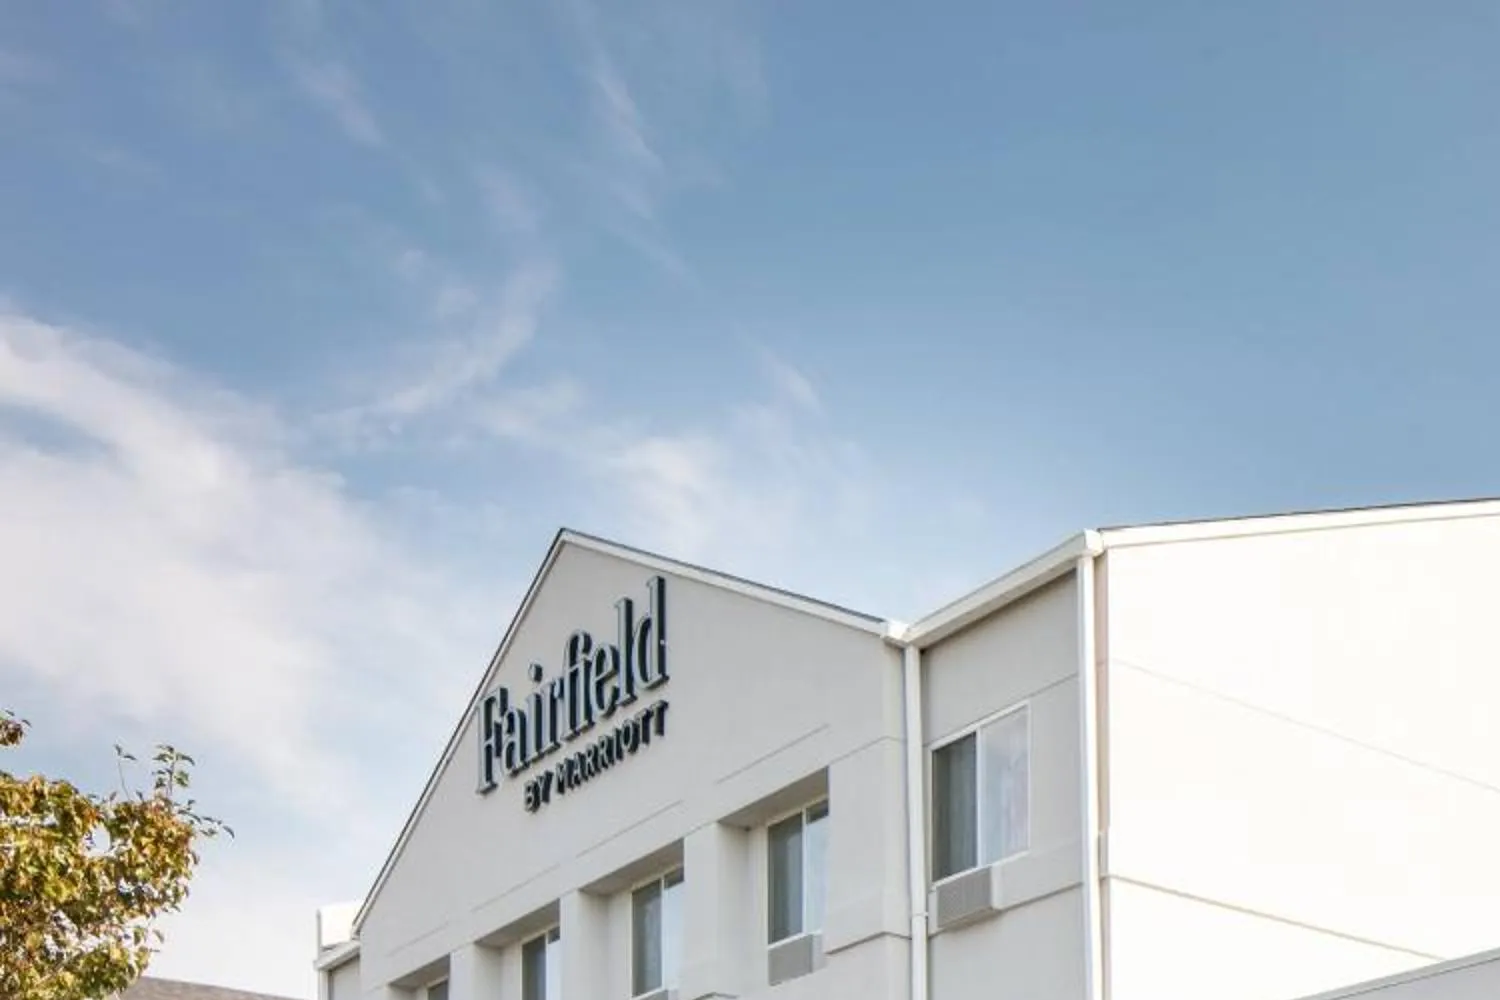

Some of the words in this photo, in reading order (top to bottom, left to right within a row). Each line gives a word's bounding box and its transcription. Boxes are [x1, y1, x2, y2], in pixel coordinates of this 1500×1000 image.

[475, 575, 670, 795] Fairfield
[524, 770, 554, 814] BY
[555, 700, 669, 795] MARRIOTT
